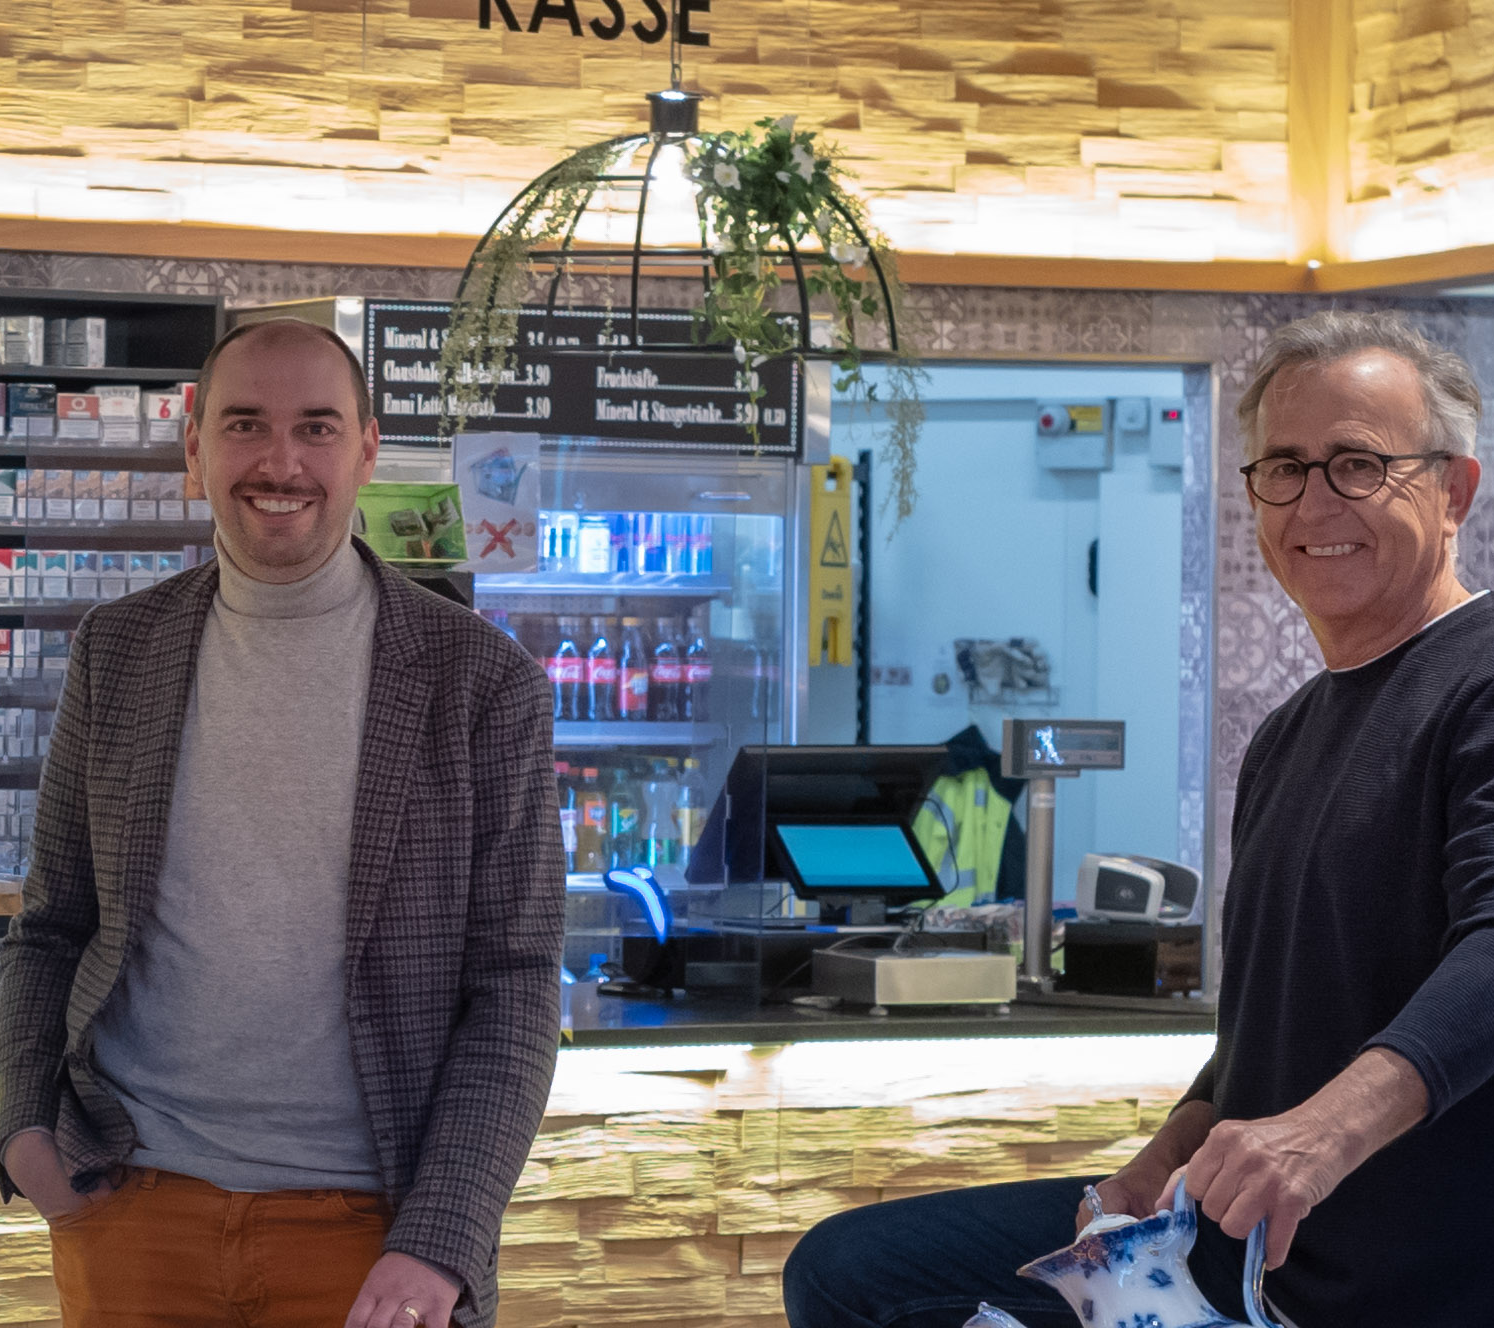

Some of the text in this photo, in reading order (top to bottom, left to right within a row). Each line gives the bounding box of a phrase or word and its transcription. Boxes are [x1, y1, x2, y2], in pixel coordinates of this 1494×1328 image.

[383, 327, 427, 350] Mineral
[429, 327, 440, 350] &
[383, 360, 445, 383] Clausthale
[596, 367, 659, 389] Fruchtsäfte
[383, 393, 416, 415] Emmi
[596, 399, 638, 422] Mineral
[640, 400, 650, 423] &
